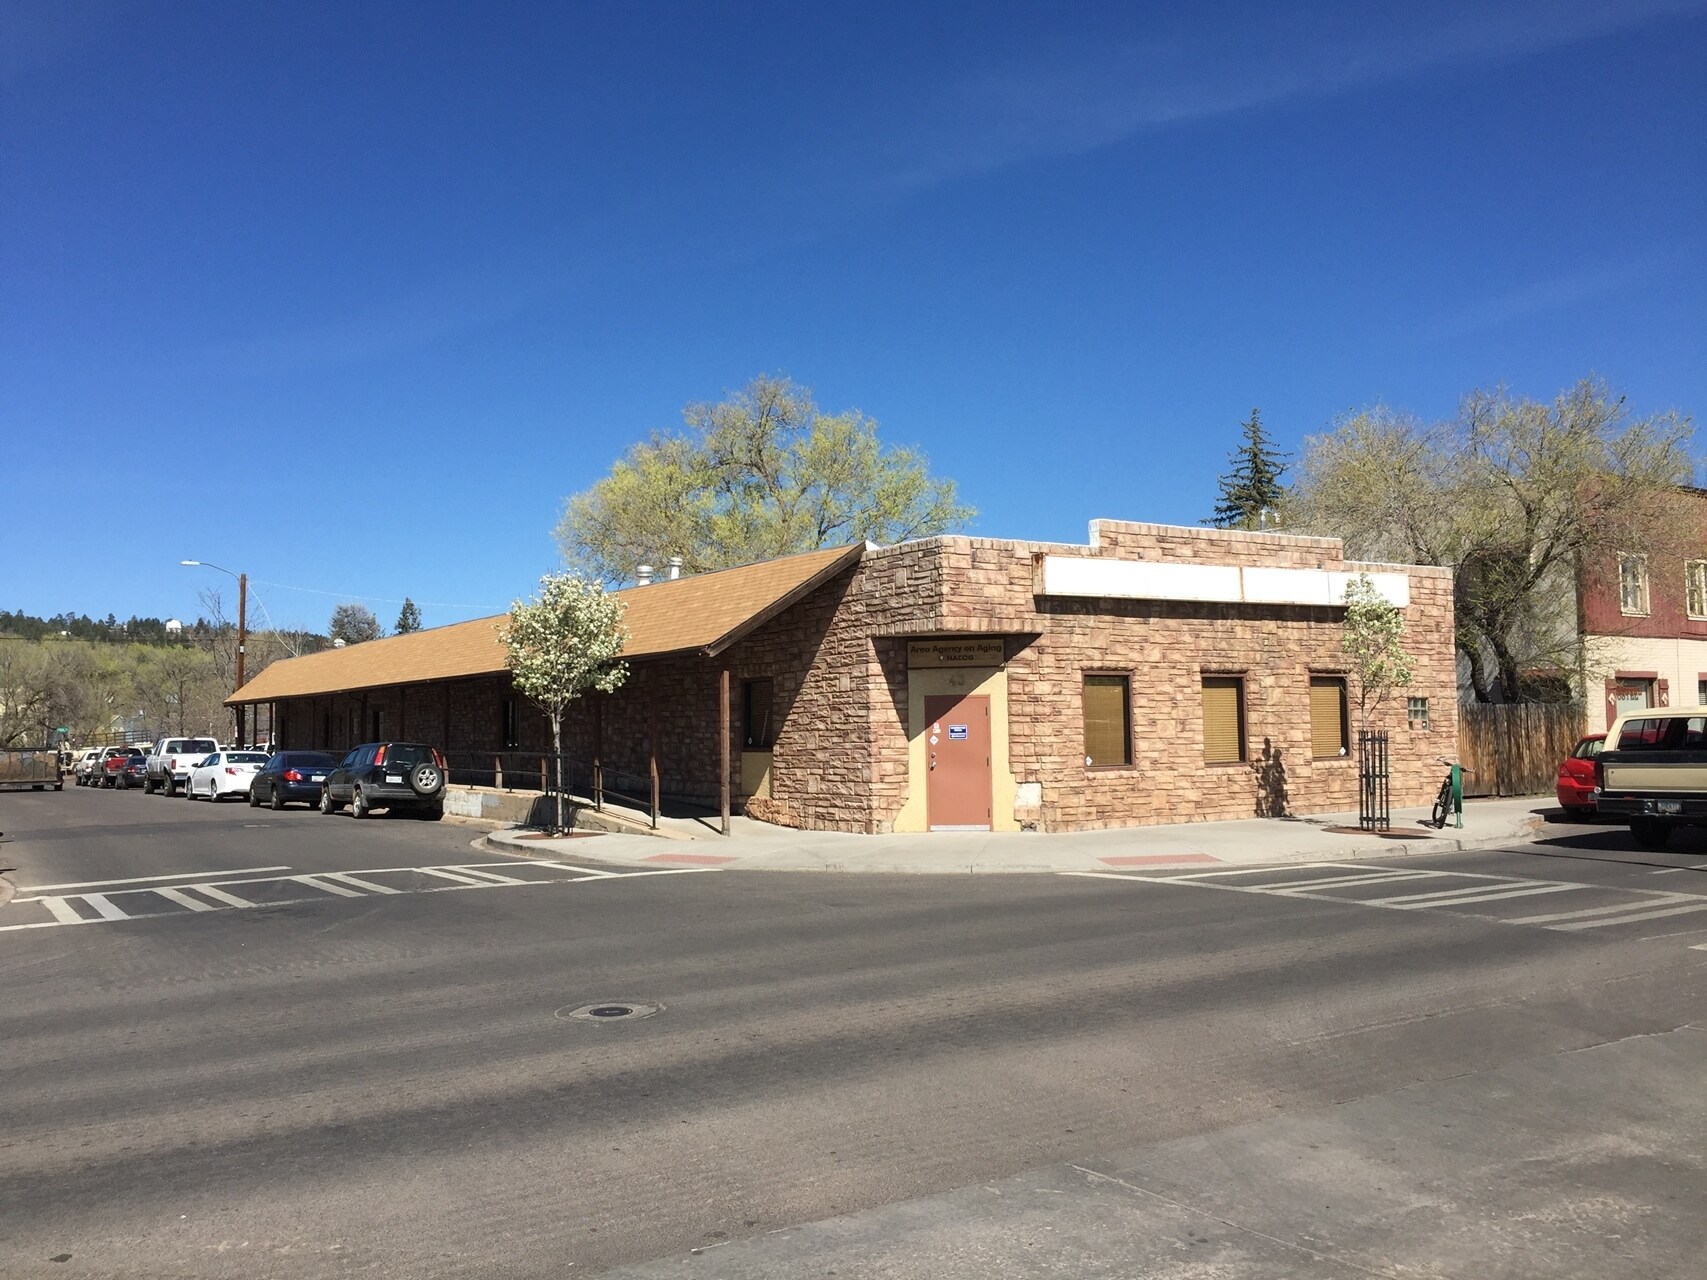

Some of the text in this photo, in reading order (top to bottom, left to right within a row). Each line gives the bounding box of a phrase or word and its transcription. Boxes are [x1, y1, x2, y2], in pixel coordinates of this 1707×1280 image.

[911, 645, 930, 653] Area
[933, 645, 962, 653] Agency
[977, 643, 1002, 653] Aging
